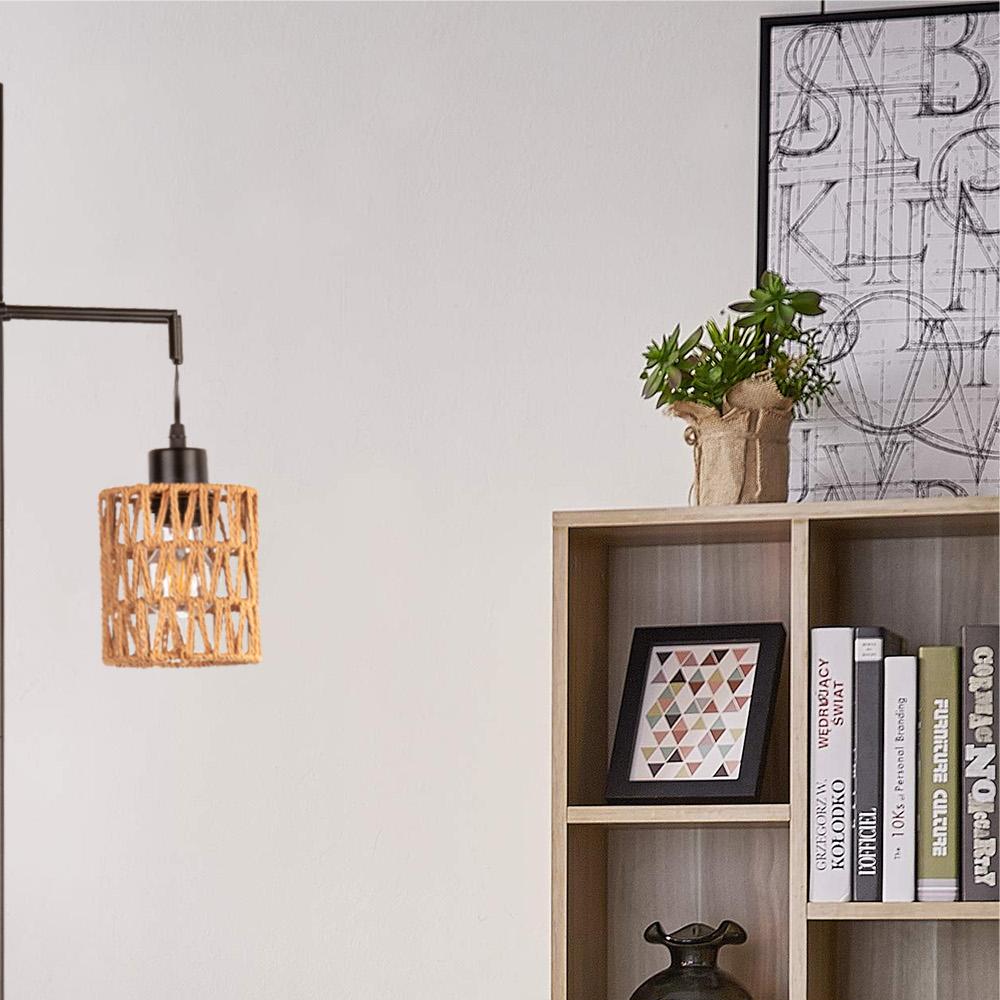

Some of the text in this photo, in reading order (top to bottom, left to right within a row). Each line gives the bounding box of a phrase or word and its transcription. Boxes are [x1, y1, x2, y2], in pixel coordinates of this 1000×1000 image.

[832, 680, 844, 726] ŚWIAT
[895, 697, 908, 742] Branding
[894, 749, 905, 792] Personal
[932, 698, 949, 857] FURNITURE CULTURE
[815, 798, 827, 871] GRZEGORZ
[831, 779, 845, 870] KOŁODKO
[891, 802, 905, 838] 10Ks
